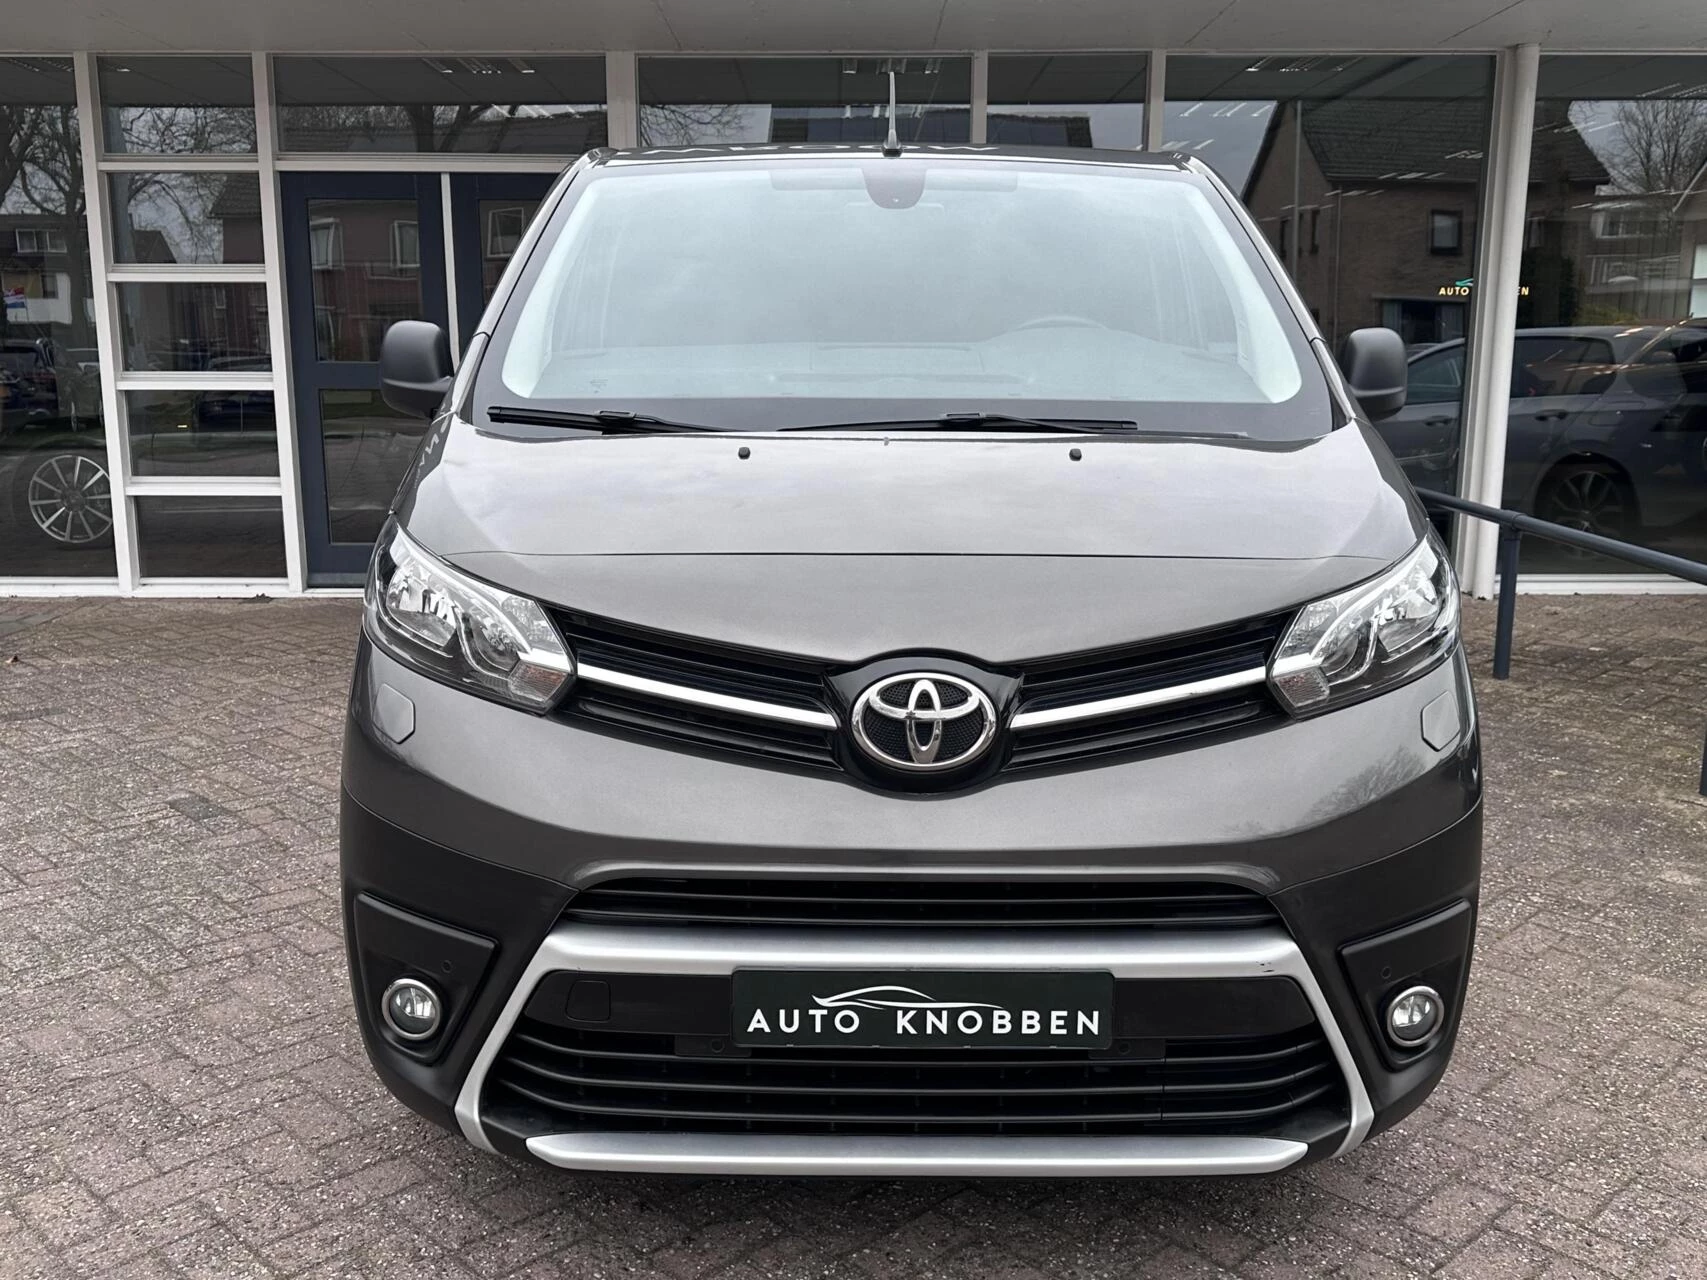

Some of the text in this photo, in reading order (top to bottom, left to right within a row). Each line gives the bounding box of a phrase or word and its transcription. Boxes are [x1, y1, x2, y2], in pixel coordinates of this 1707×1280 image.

[1438, 286, 1470, 296] AUTO
[747, 1009, 1100, 1035] AUTO KNOBBEN
